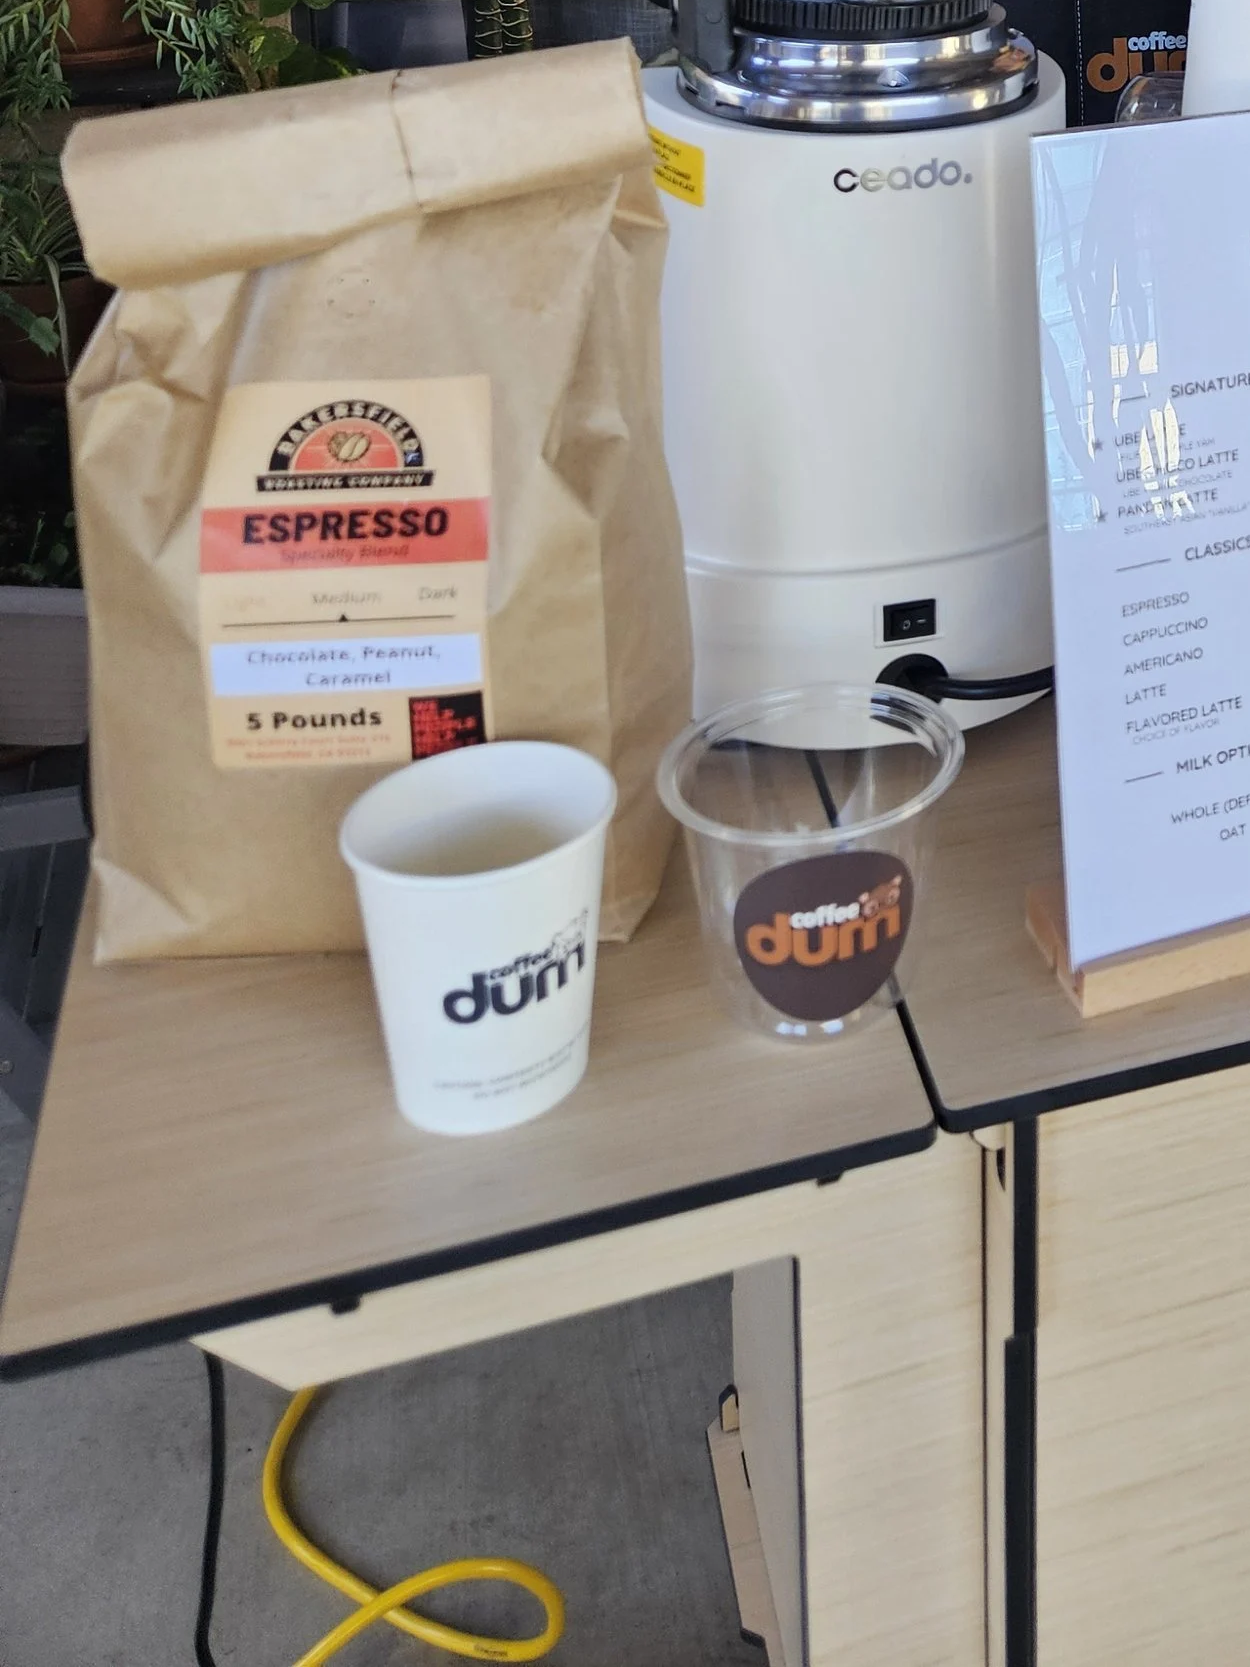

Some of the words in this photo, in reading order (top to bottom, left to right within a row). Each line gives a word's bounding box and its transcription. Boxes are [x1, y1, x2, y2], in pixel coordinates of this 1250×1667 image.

[1128, 31, 1187, 51] coffee
[276, 401, 421, 458] BAKERSFIELD
[1114, 430, 1140, 447] UBE
[1116, 467, 1142, 483] UBE
[1199, 448, 1240, 469] LATTE
[242, 506, 450, 546] ESPRESSO
[417, 585, 458, 602] Dark
[1121, 591, 1191, 618] ESPRESSO
[1122, 616, 1209, 647] CAPPUCCINO
[247, 646, 356, 665] Chocolate,
[362, 644, 441, 663] Peanut,
[1123, 646, 1204, 676] AMERICANO
[305, 670, 392, 687] Caramel
[1125, 683, 1168, 706] LATTE
[247, 712, 263, 731] 5
[271, 707, 383, 730] Pounds
[1126, 706, 1199, 734] FLAVORED
[1201, 695, 1243, 718] LATTE
[1175, 752, 1213, 775] MILK
[1171, 801, 1220, 825] WHOLE
[1219, 823, 1247, 842] OAT
[789, 901, 861, 930] coffee
